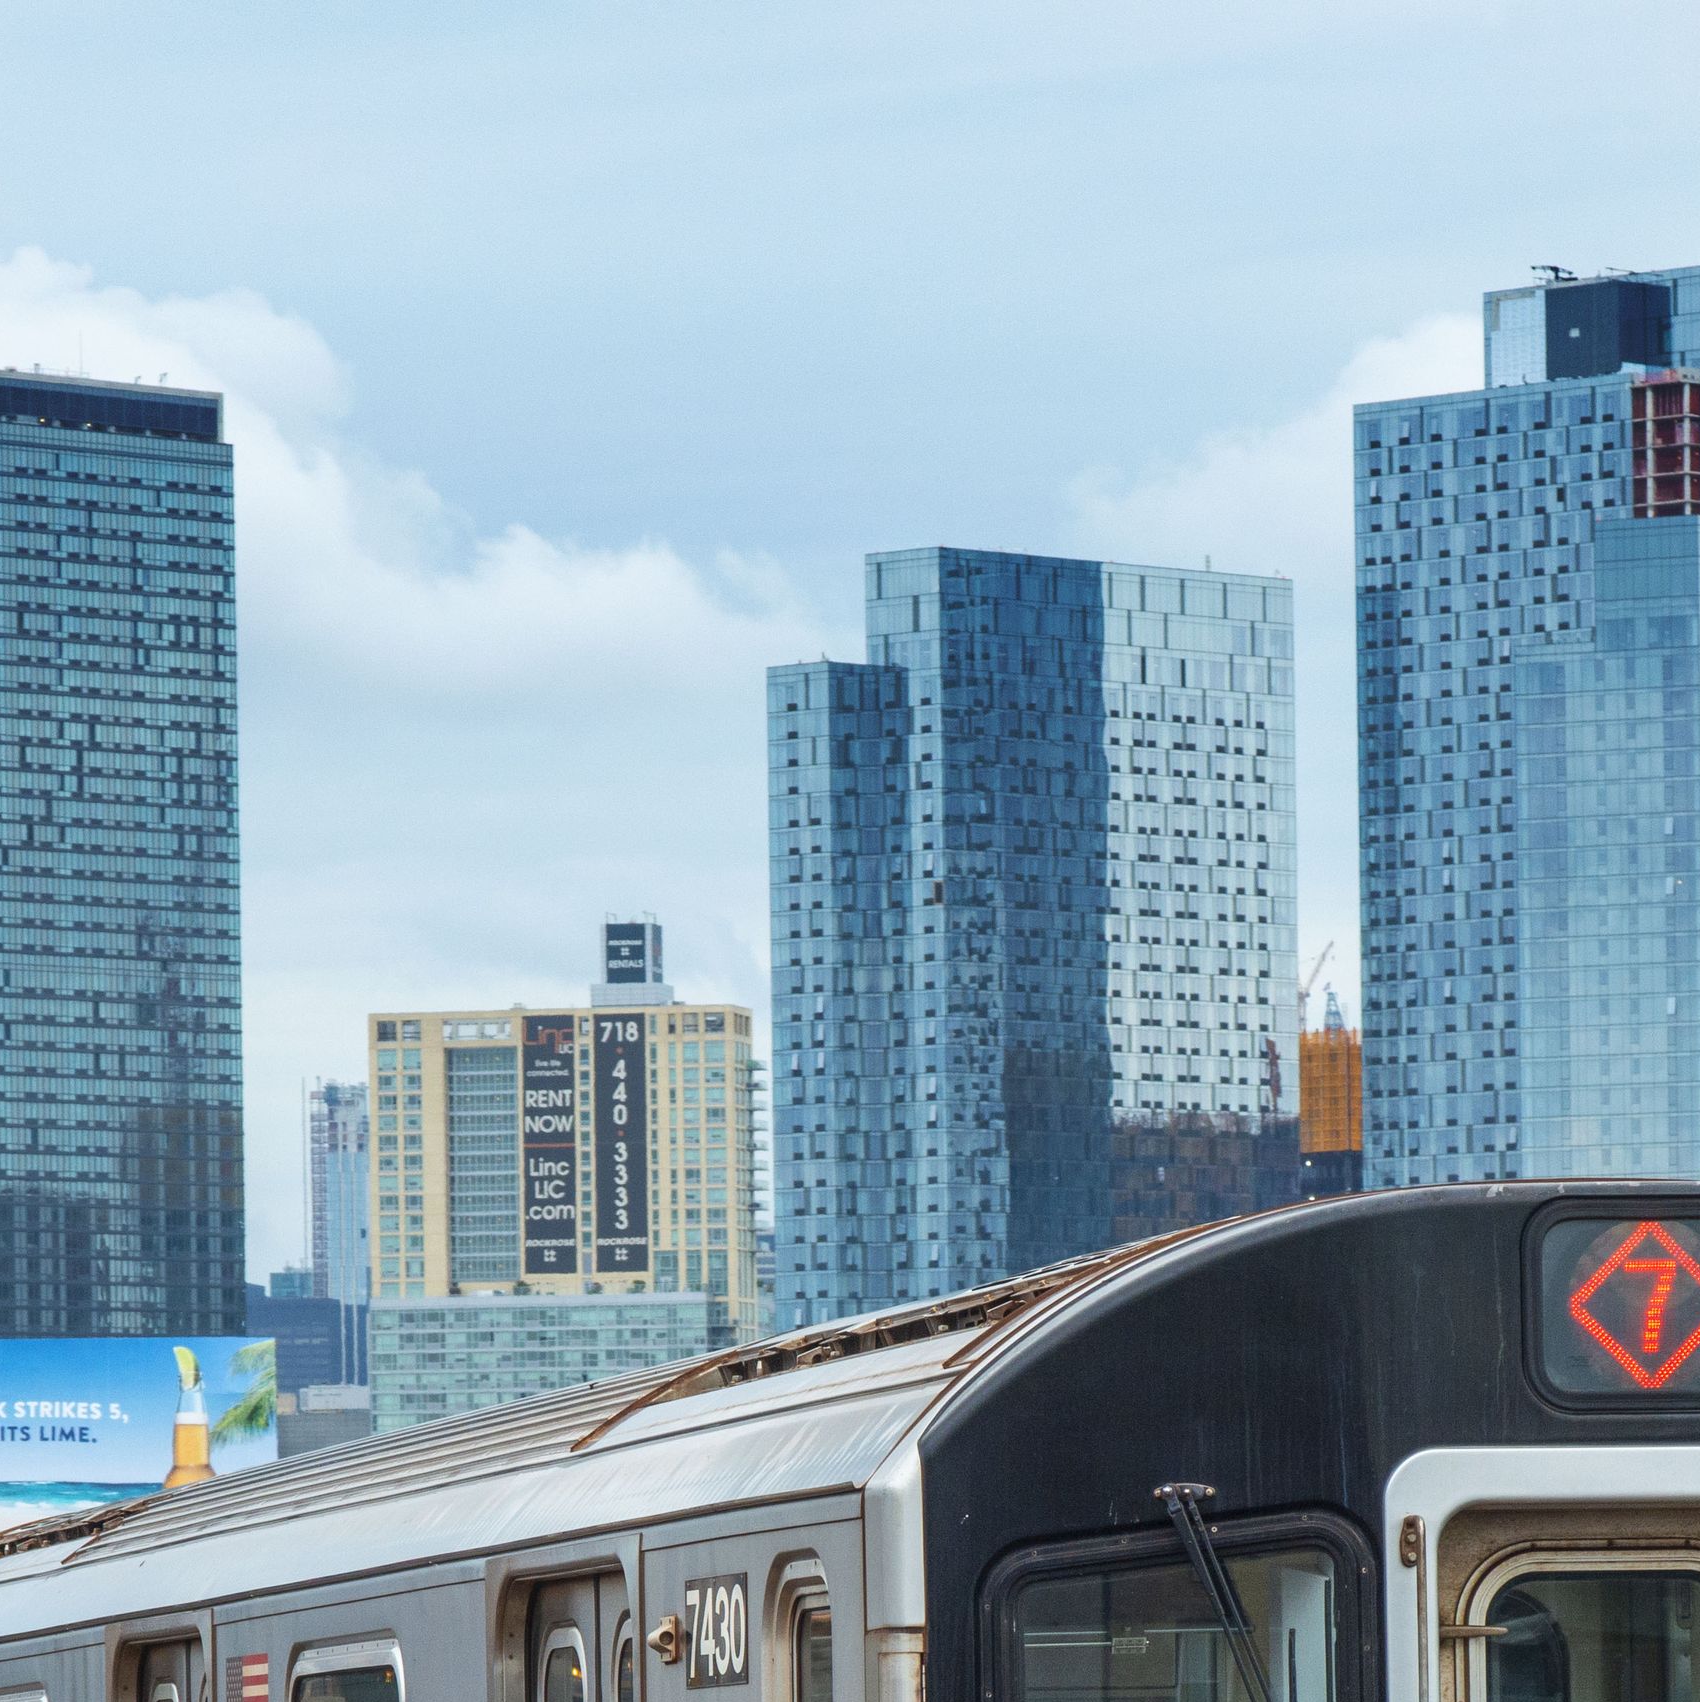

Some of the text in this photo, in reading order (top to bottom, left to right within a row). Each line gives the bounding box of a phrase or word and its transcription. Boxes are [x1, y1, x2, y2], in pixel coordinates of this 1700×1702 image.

[608, 960, 644, 968] RENTALS
[600, 1021, 638, 1042] 718
[526, 1089, 573, 1108] RENT
[525, 1115, 573, 1134] NOW
[529, 1158, 570, 1177] Linc
[535, 1180, 565, 1199] LIC
[525, 1203, 575, 1221] .com
[525, 1238, 575, 1248] ROCKROSE
[597, 1236, 647, 1247] ROCKROSE
[1623, 1258, 1677, 1354] 7
[14, 1401, 101, 1419] STRIKES
[109, 1403, 129, 1424] 5,
[0, 1426, 31, 1442] ITS
[40, 1426, 97, 1443] LIME.
[686, 1583, 746, 1678] 7430
